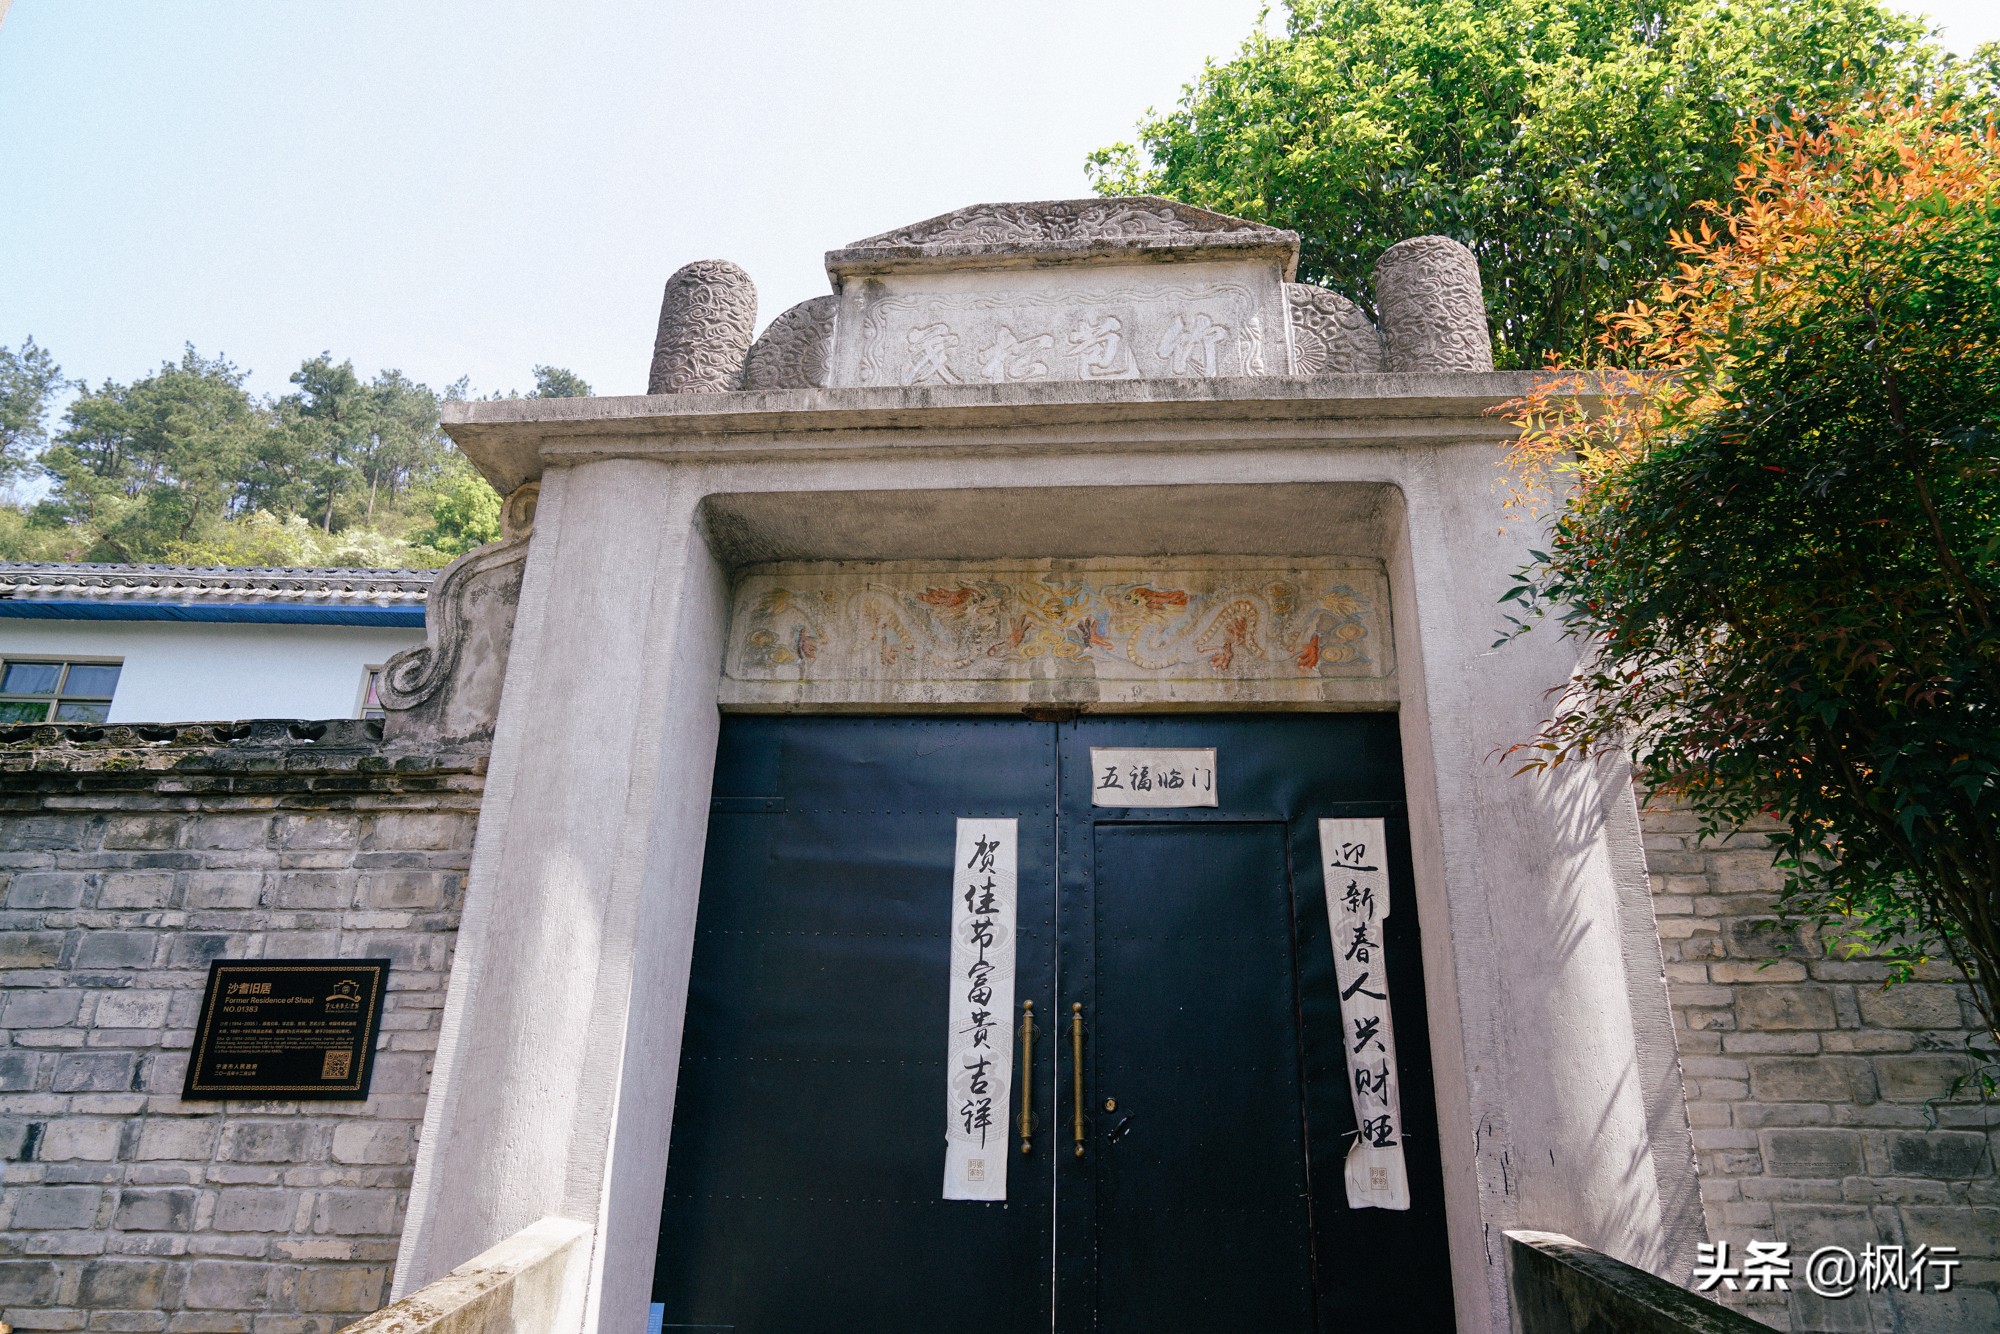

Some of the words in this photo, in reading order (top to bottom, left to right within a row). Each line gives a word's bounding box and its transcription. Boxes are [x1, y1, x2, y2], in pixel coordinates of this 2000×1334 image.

[1096, 764, 1212, 792] 五福临门
[224, 996, 249, 1004] Former
[250, 996, 286, 1004] Residence
[286, 996, 295, 1004] of
[294, 996, 315, 1005] Shaqi
[959, 834, 1001, 1150] 贺佳节富贵吉祥
[1331, 842, 1398, 1148] 迎新春人兴财旺
